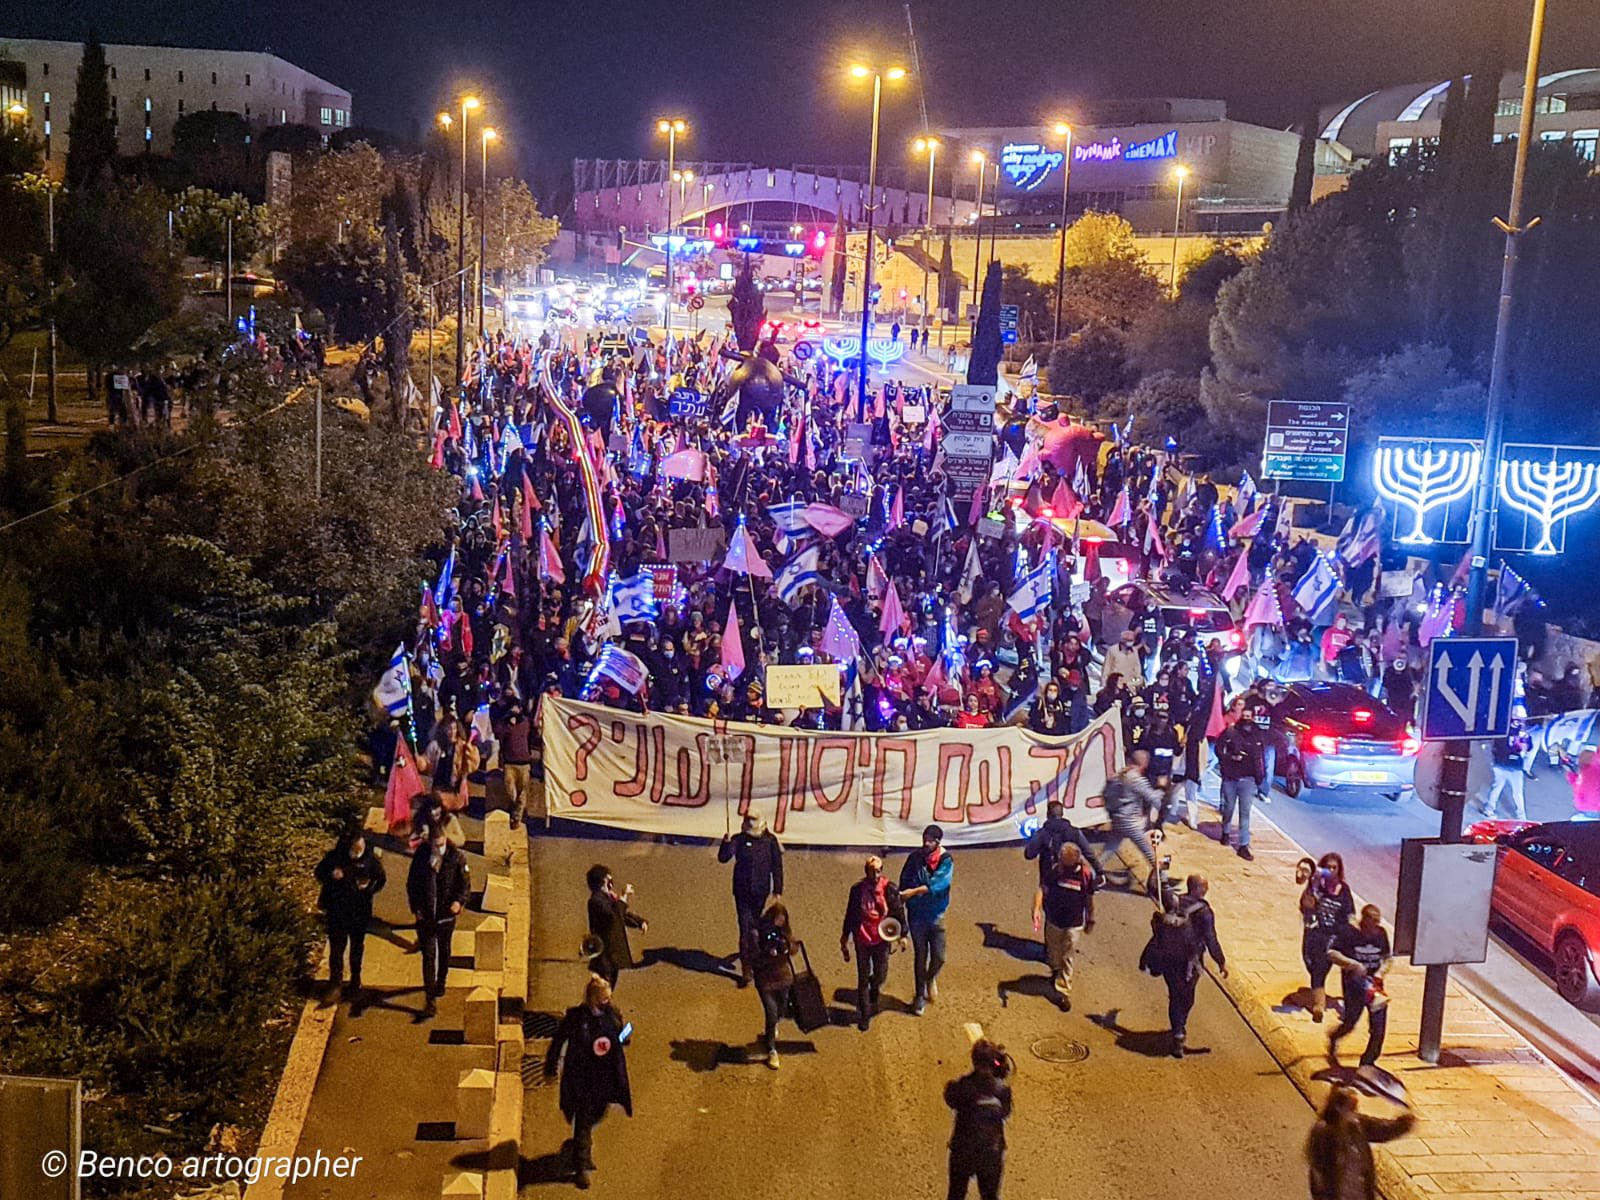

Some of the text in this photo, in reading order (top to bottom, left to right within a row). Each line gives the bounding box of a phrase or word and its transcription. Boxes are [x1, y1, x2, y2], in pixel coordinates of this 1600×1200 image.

[567, 712, 1118, 834] מה עם חיסון לעוני?
